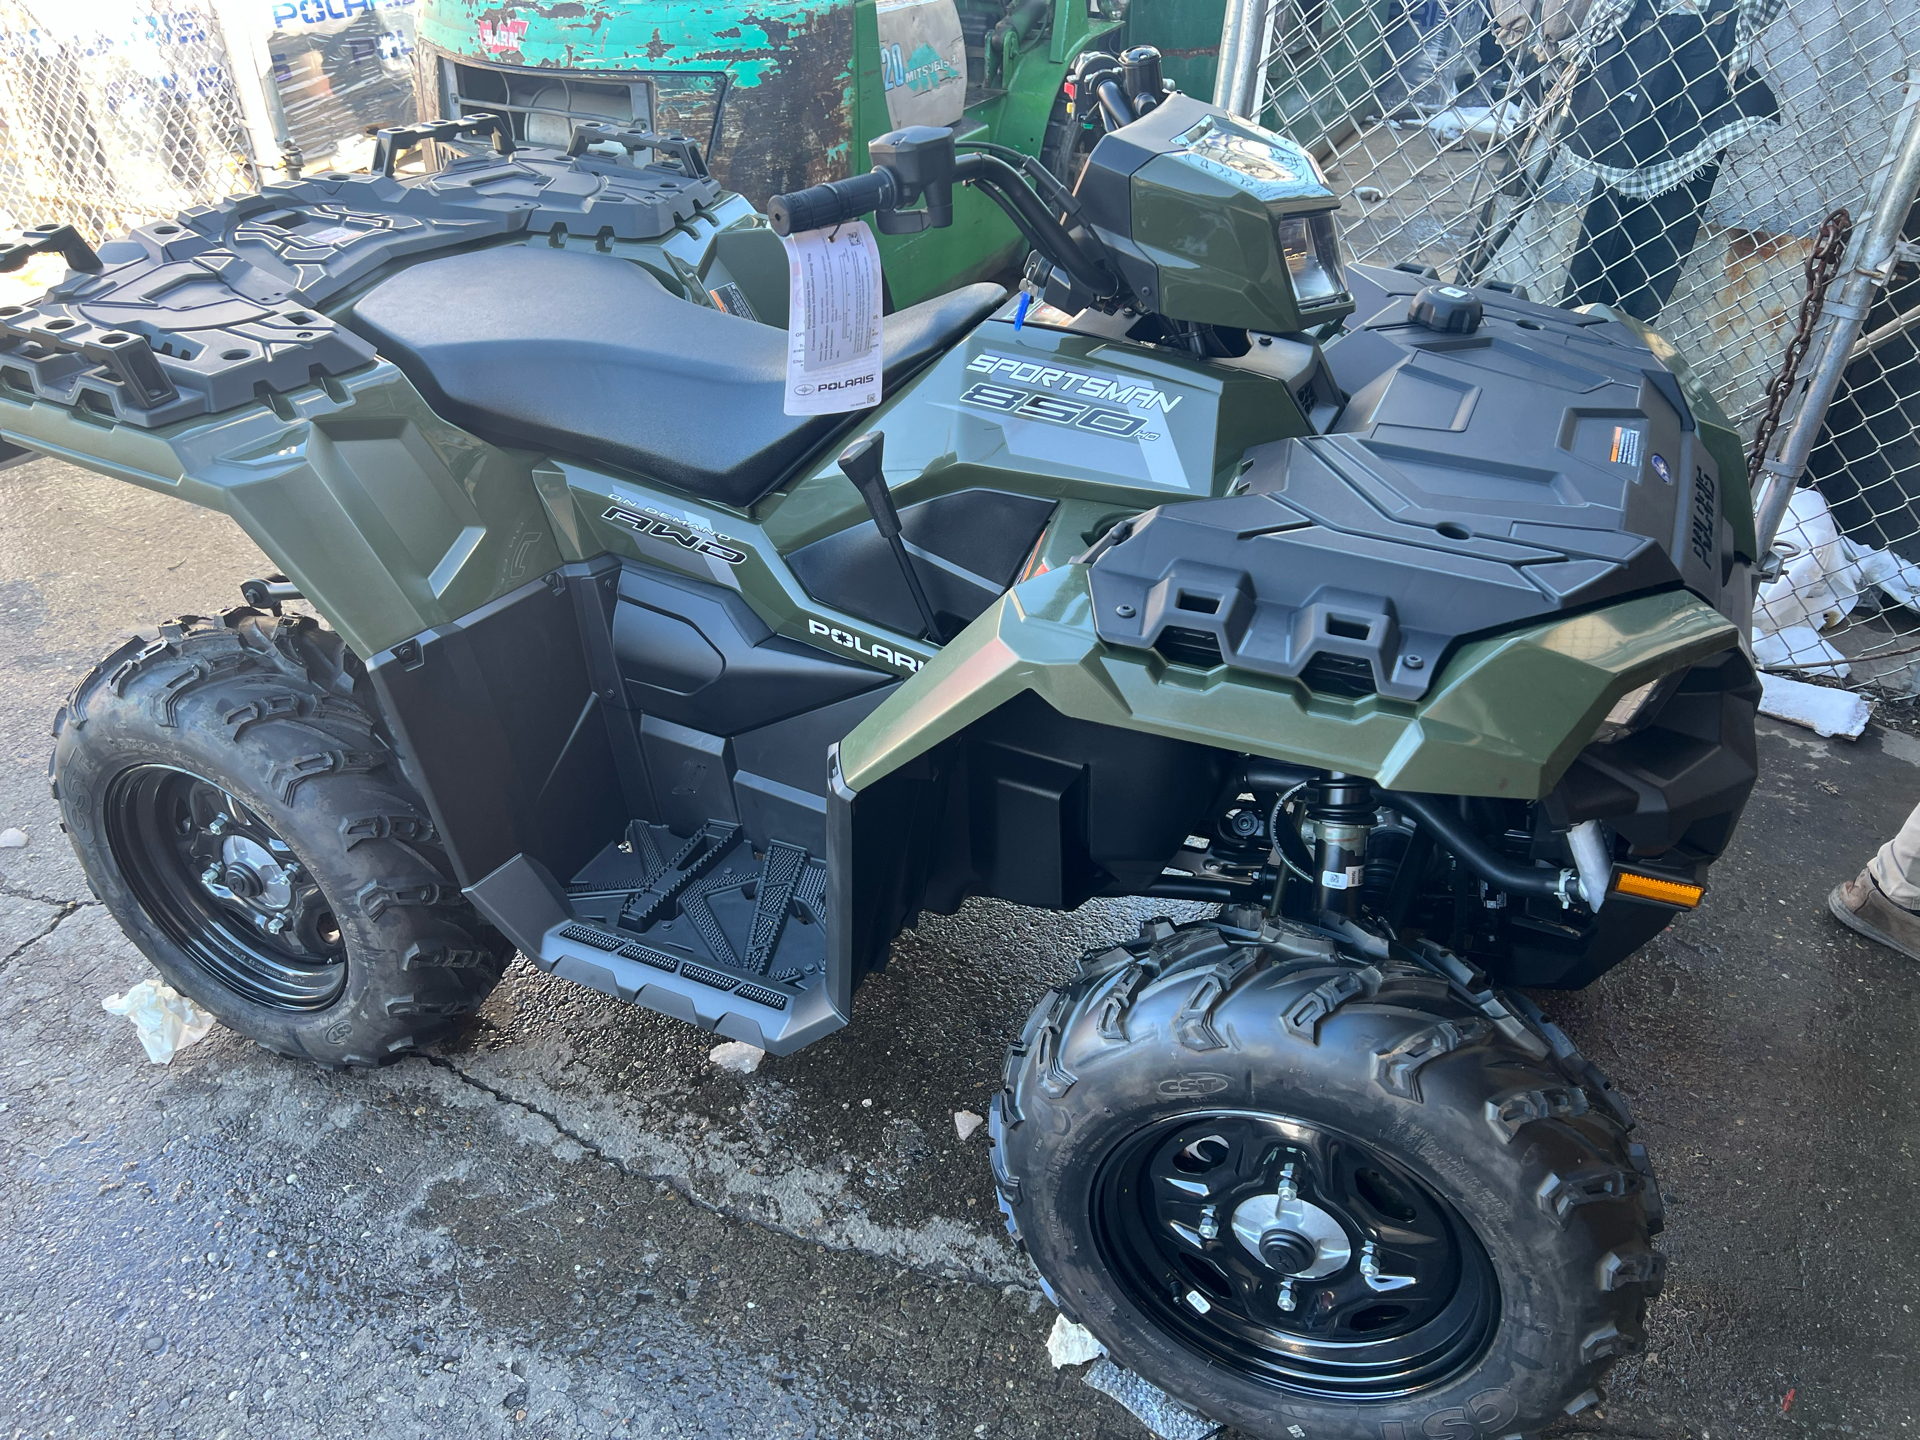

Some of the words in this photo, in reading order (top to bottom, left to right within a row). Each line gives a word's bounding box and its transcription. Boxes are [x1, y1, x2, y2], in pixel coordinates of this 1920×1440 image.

[881, 43, 904, 92] 20
[818, 374, 874, 392] POLARIS
[966, 354, 1183, 413] SPORTSMAN
[960, 383, 1149, 438] 850
[601, 506, 748, 564] AWD
[608, 493, 637, 507] ON
[644, 506, 732, 541] DEMAND
[1160, 1078, 1217, 1092] CST
